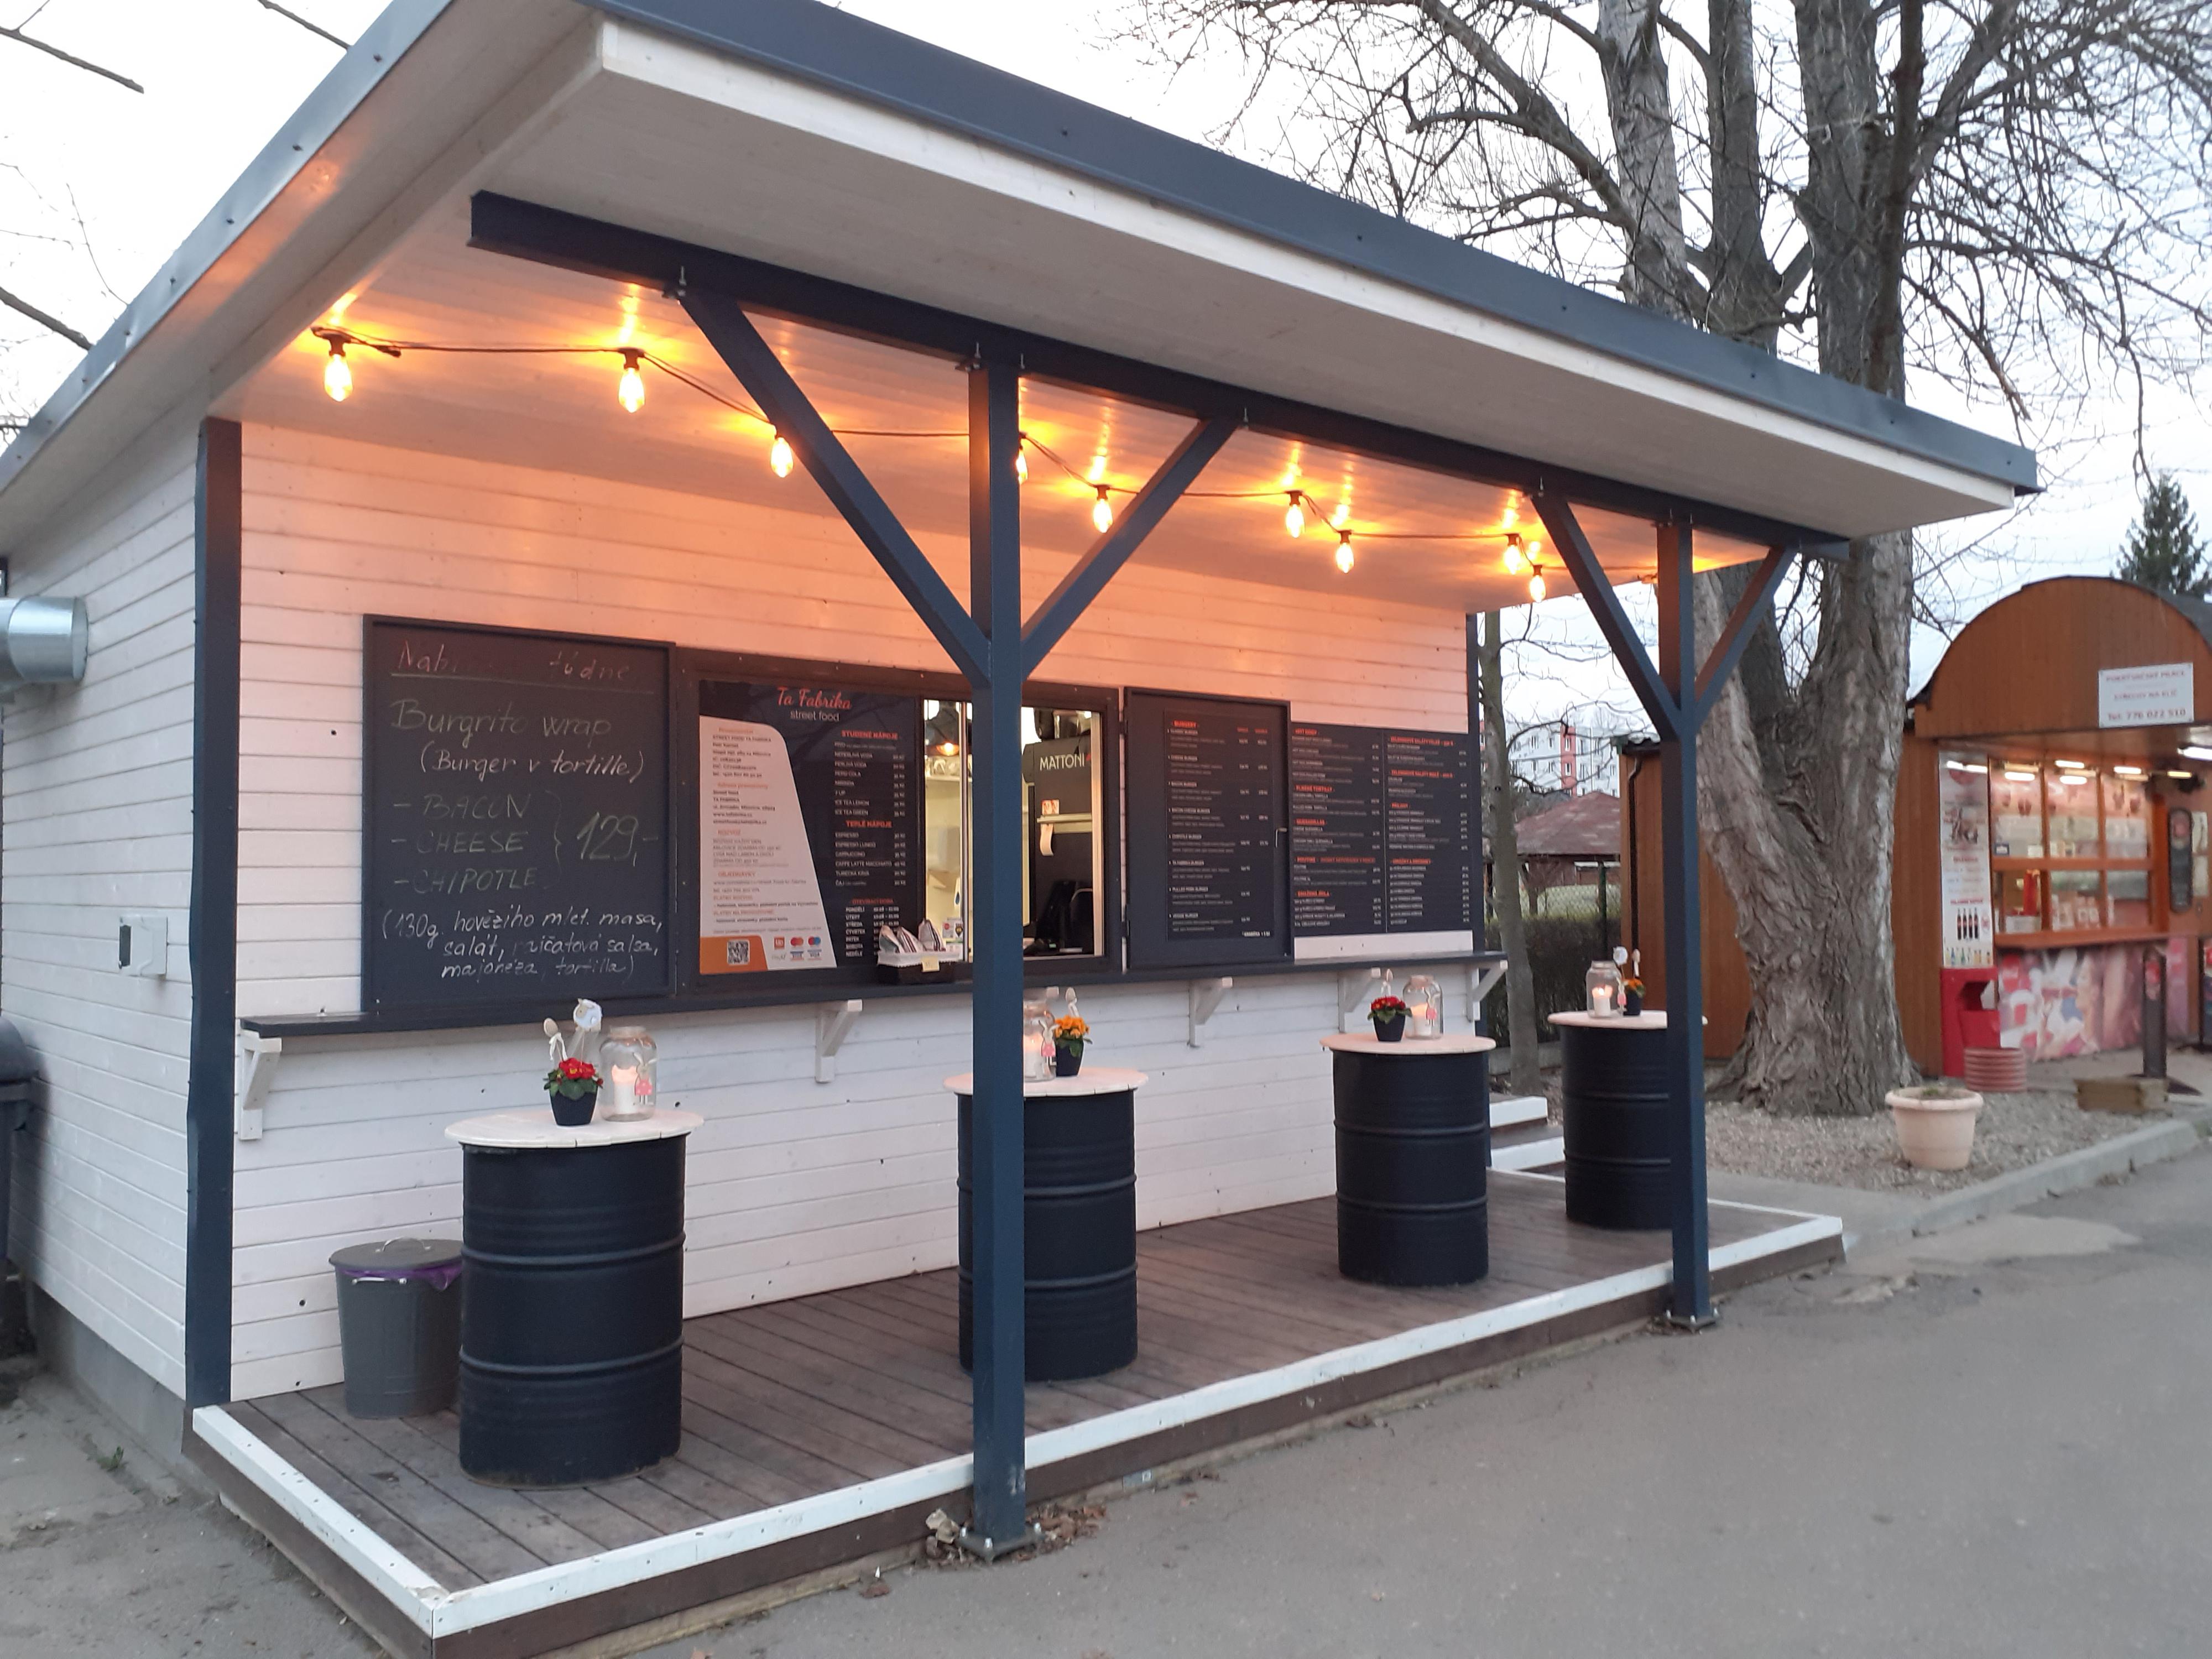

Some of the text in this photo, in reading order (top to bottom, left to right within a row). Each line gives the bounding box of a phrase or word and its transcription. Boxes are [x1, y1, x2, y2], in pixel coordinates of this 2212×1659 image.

[777, 685, 852, 709] Ta Fabrika
[390, 698, 612, 749] Burgrito wrap
[790, 709, 840, 722] street food
[420, 740, 644, 783] (Burger v tortille)
[1040, 752, 1084, 771] MATTONI
[598, 911, 663, 932] masa,
[607, 934, 659, 957] salsa,
